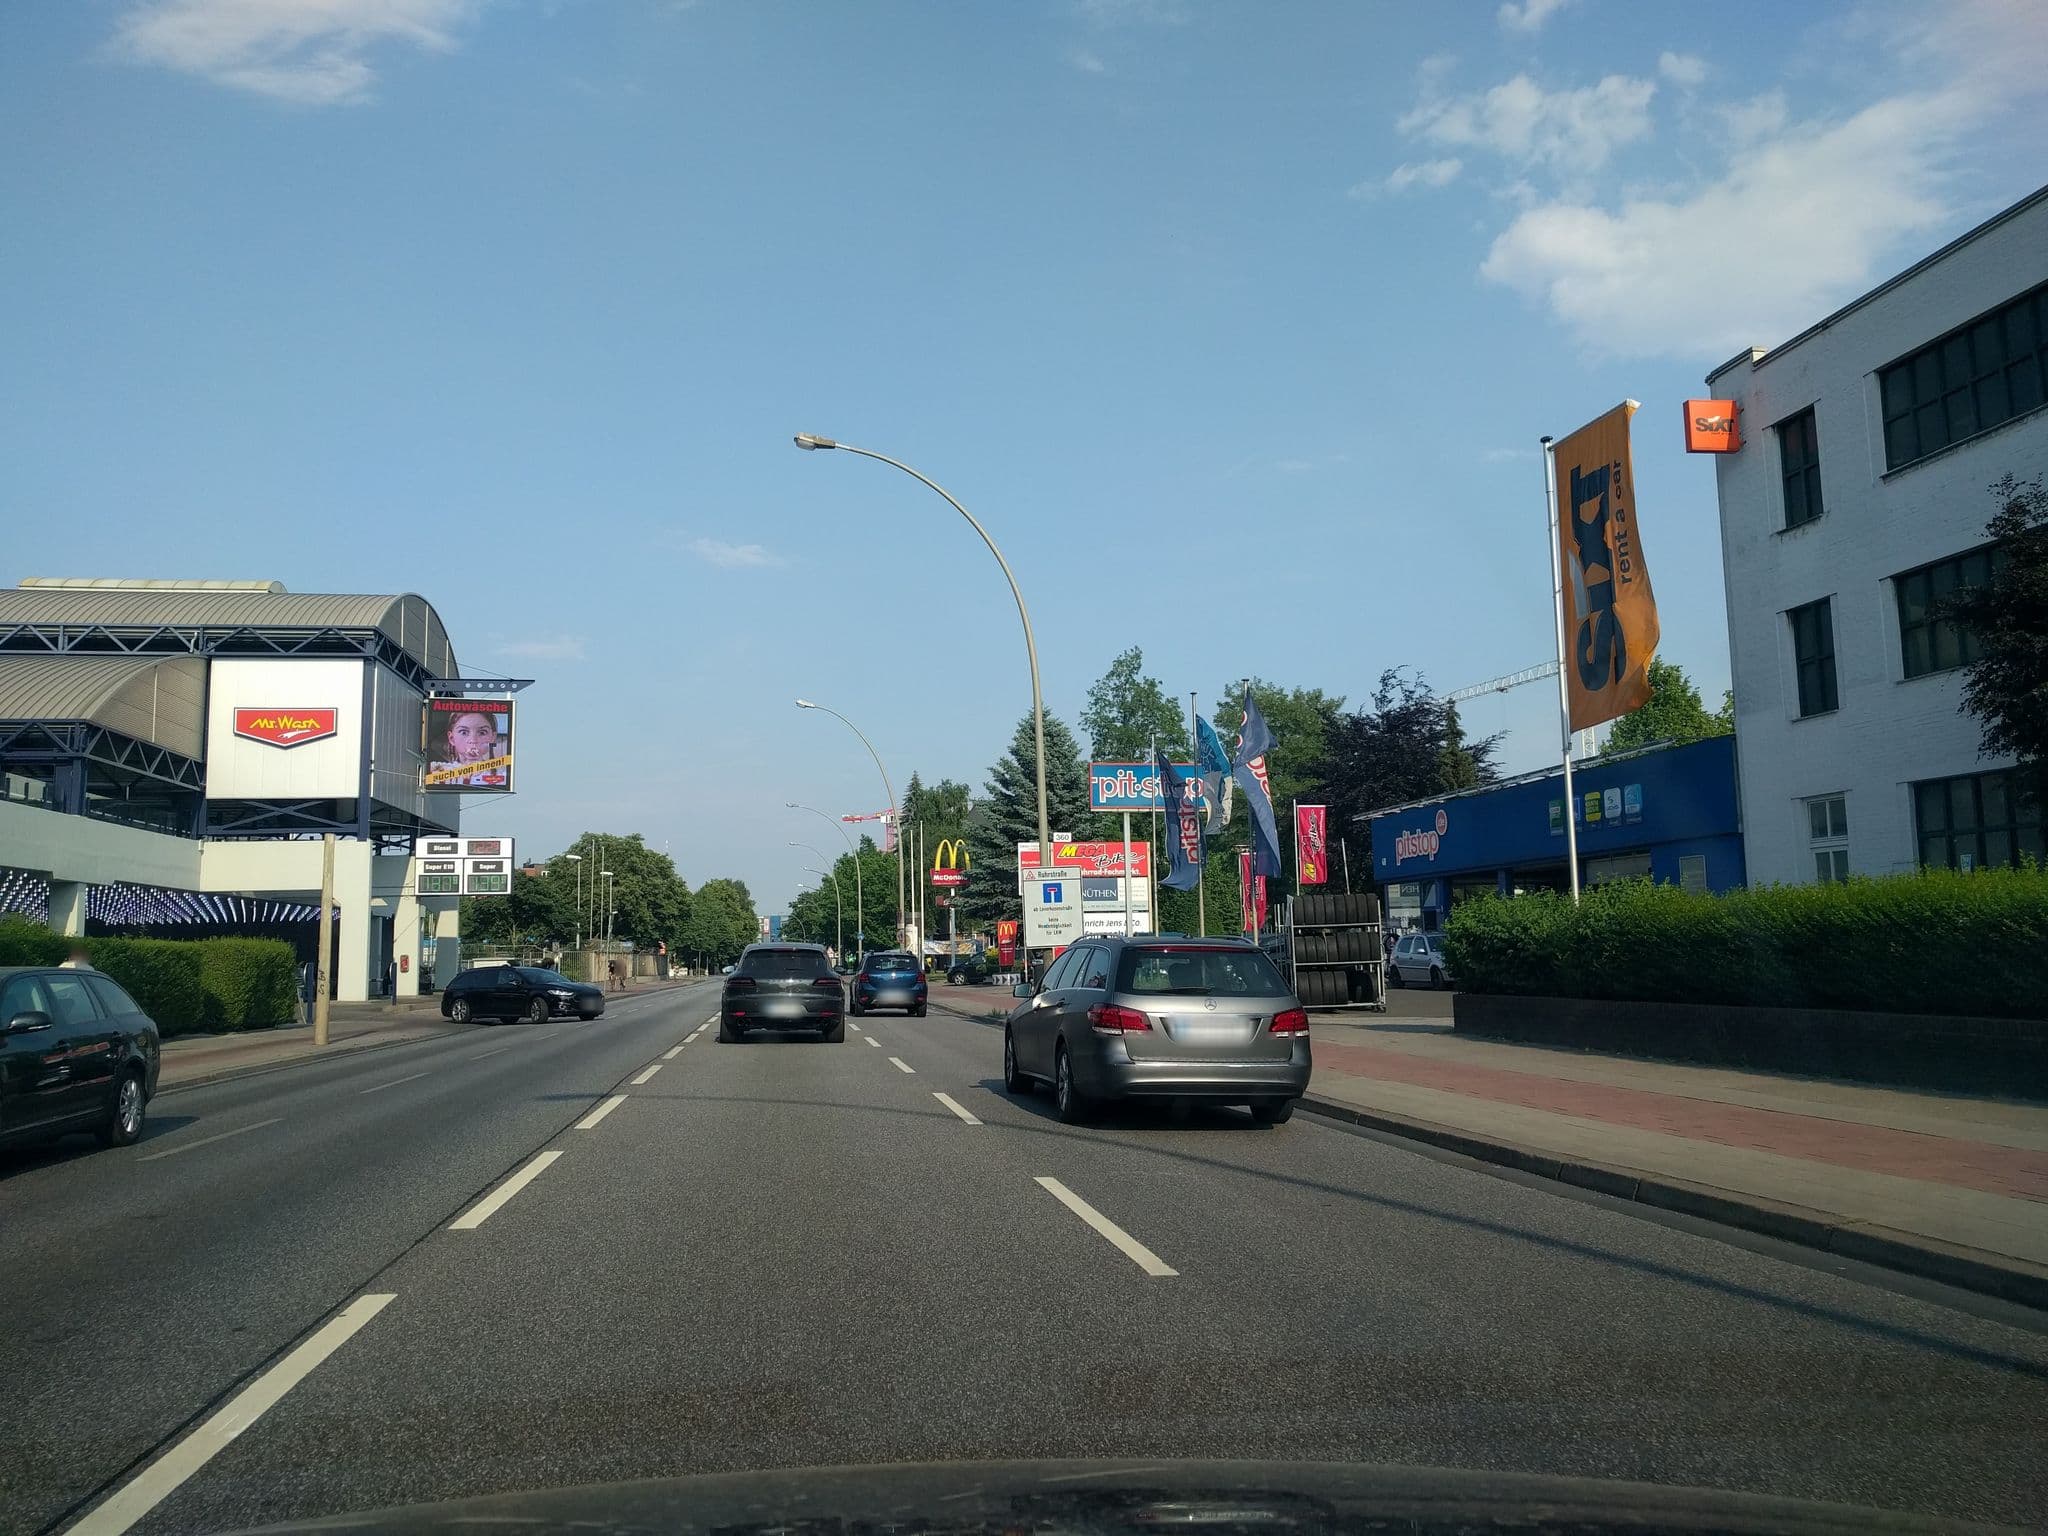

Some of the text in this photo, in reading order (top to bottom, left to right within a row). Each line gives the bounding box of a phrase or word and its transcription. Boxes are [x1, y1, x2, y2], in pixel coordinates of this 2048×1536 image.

[1612, 459, 1632, 584] rent a car
[433, 701, 508, 712] Autowäsche
[432, 758, 505, 782] auch von innen!
[1058, 844, 1105, 858] MEGA
[1395, 828, 1439, 866] pitstop
[1038, 870, 1067, 878] Ruhrstraße
